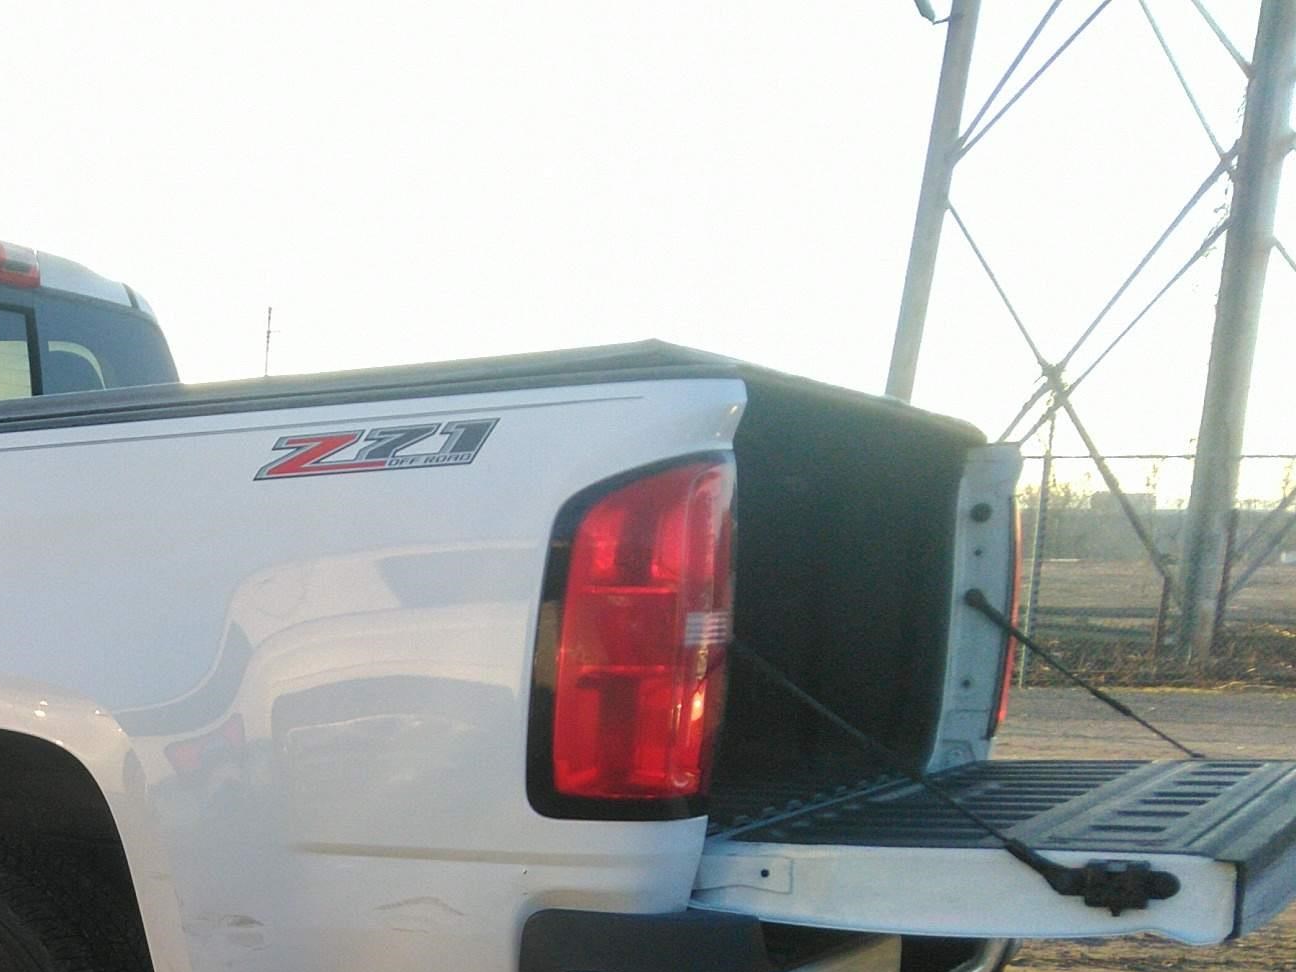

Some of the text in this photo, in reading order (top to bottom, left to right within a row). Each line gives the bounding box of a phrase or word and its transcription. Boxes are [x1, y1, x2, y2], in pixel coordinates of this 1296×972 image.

[253, 418, 500, 481] Z71
[387, 452, 473, 468] OFF ROAD
